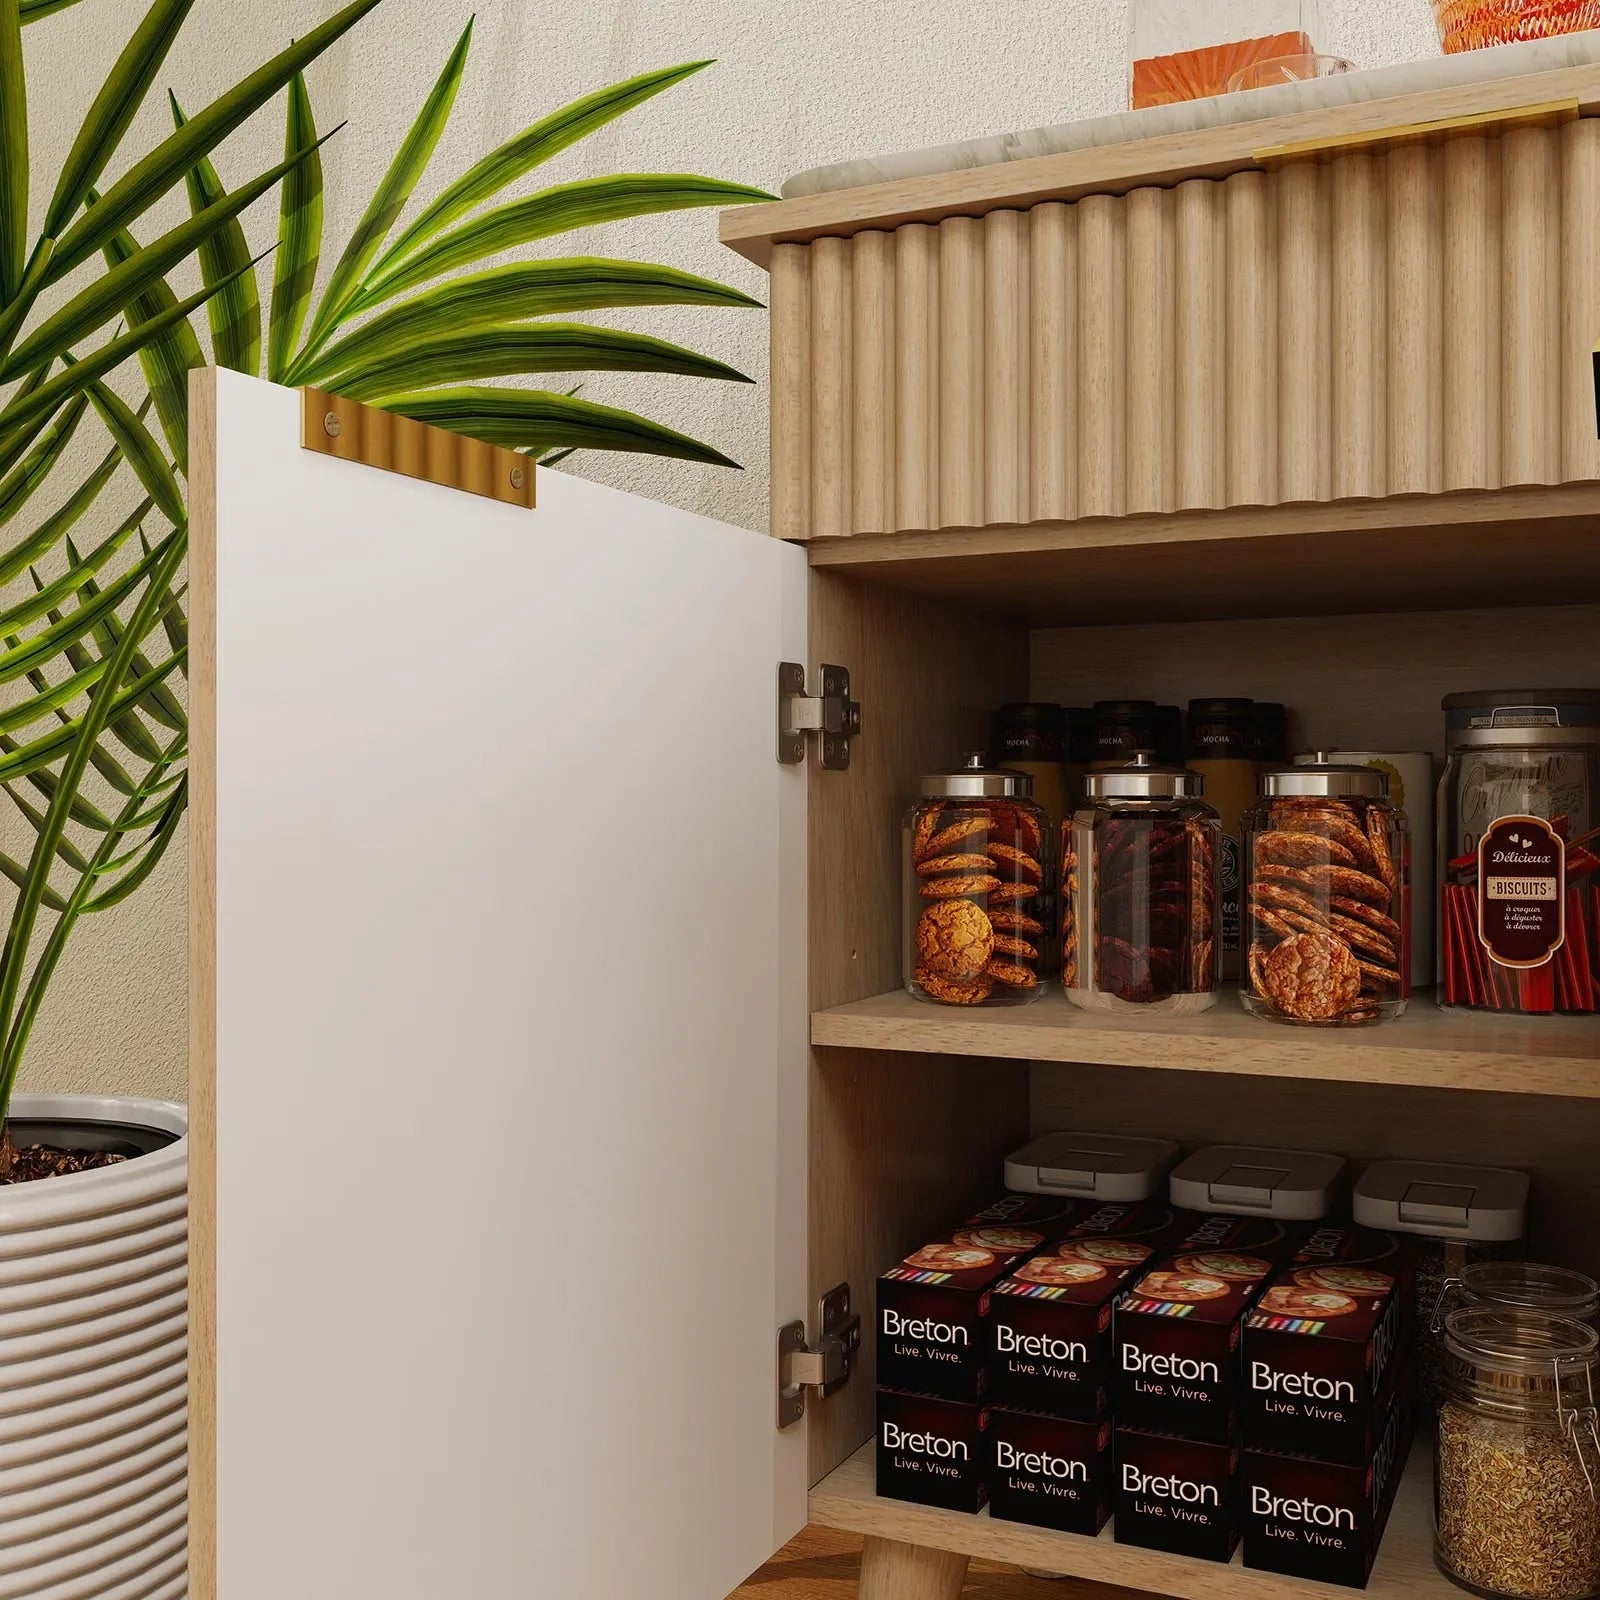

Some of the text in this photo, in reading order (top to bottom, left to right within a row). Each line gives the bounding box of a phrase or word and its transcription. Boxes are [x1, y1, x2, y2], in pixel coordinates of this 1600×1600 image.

[1005, 738, 1030, 747] MOCHA
[1099, 736, 1123, 745] MOCHA
[1202, 735, 1231, 744] MOCHA
[1492, 850, 1552, 864] Délicieux
[1496, 881, 1547, 896] BISCUITS
[1504, 913, 1543, 922] à déguster
[1506, 904, 1541, 914] à croquer
[1506, 922, 1541, 931] à dévorer
[884, 1309, 968, 1346] Breton
[894, 1343, 962, 1364] Live. Vivre.
[997, 1324, 1087, 1363] Breton
[1009, 1360, 1080, 1381] Live. Vivre.
[1122, 1343, 1219, 1384] Breton
[1135, 1379, 1211, 1402] Live. Vivre.
[1251, 1361, 1355, 1403] Breton
[1265, 1399, 1347, 1422] Live. Vivre.
[884, 1421, 968, 1461] Breton
[894, 1456, 962, 1478] Live. Vivre.
[997, 1440, 1087, 1482] Breton
[1009, 1476, 1080, 1500] Live. Vivre.
[1122, 1463, 1219, 1507] Breton
[1135, 1500, 1211, 1524] Live. Vivre.
[1251, 1485, 1355, 1531] Breton
[1265, 1523, 1347, 1549] Live. Vivre.
